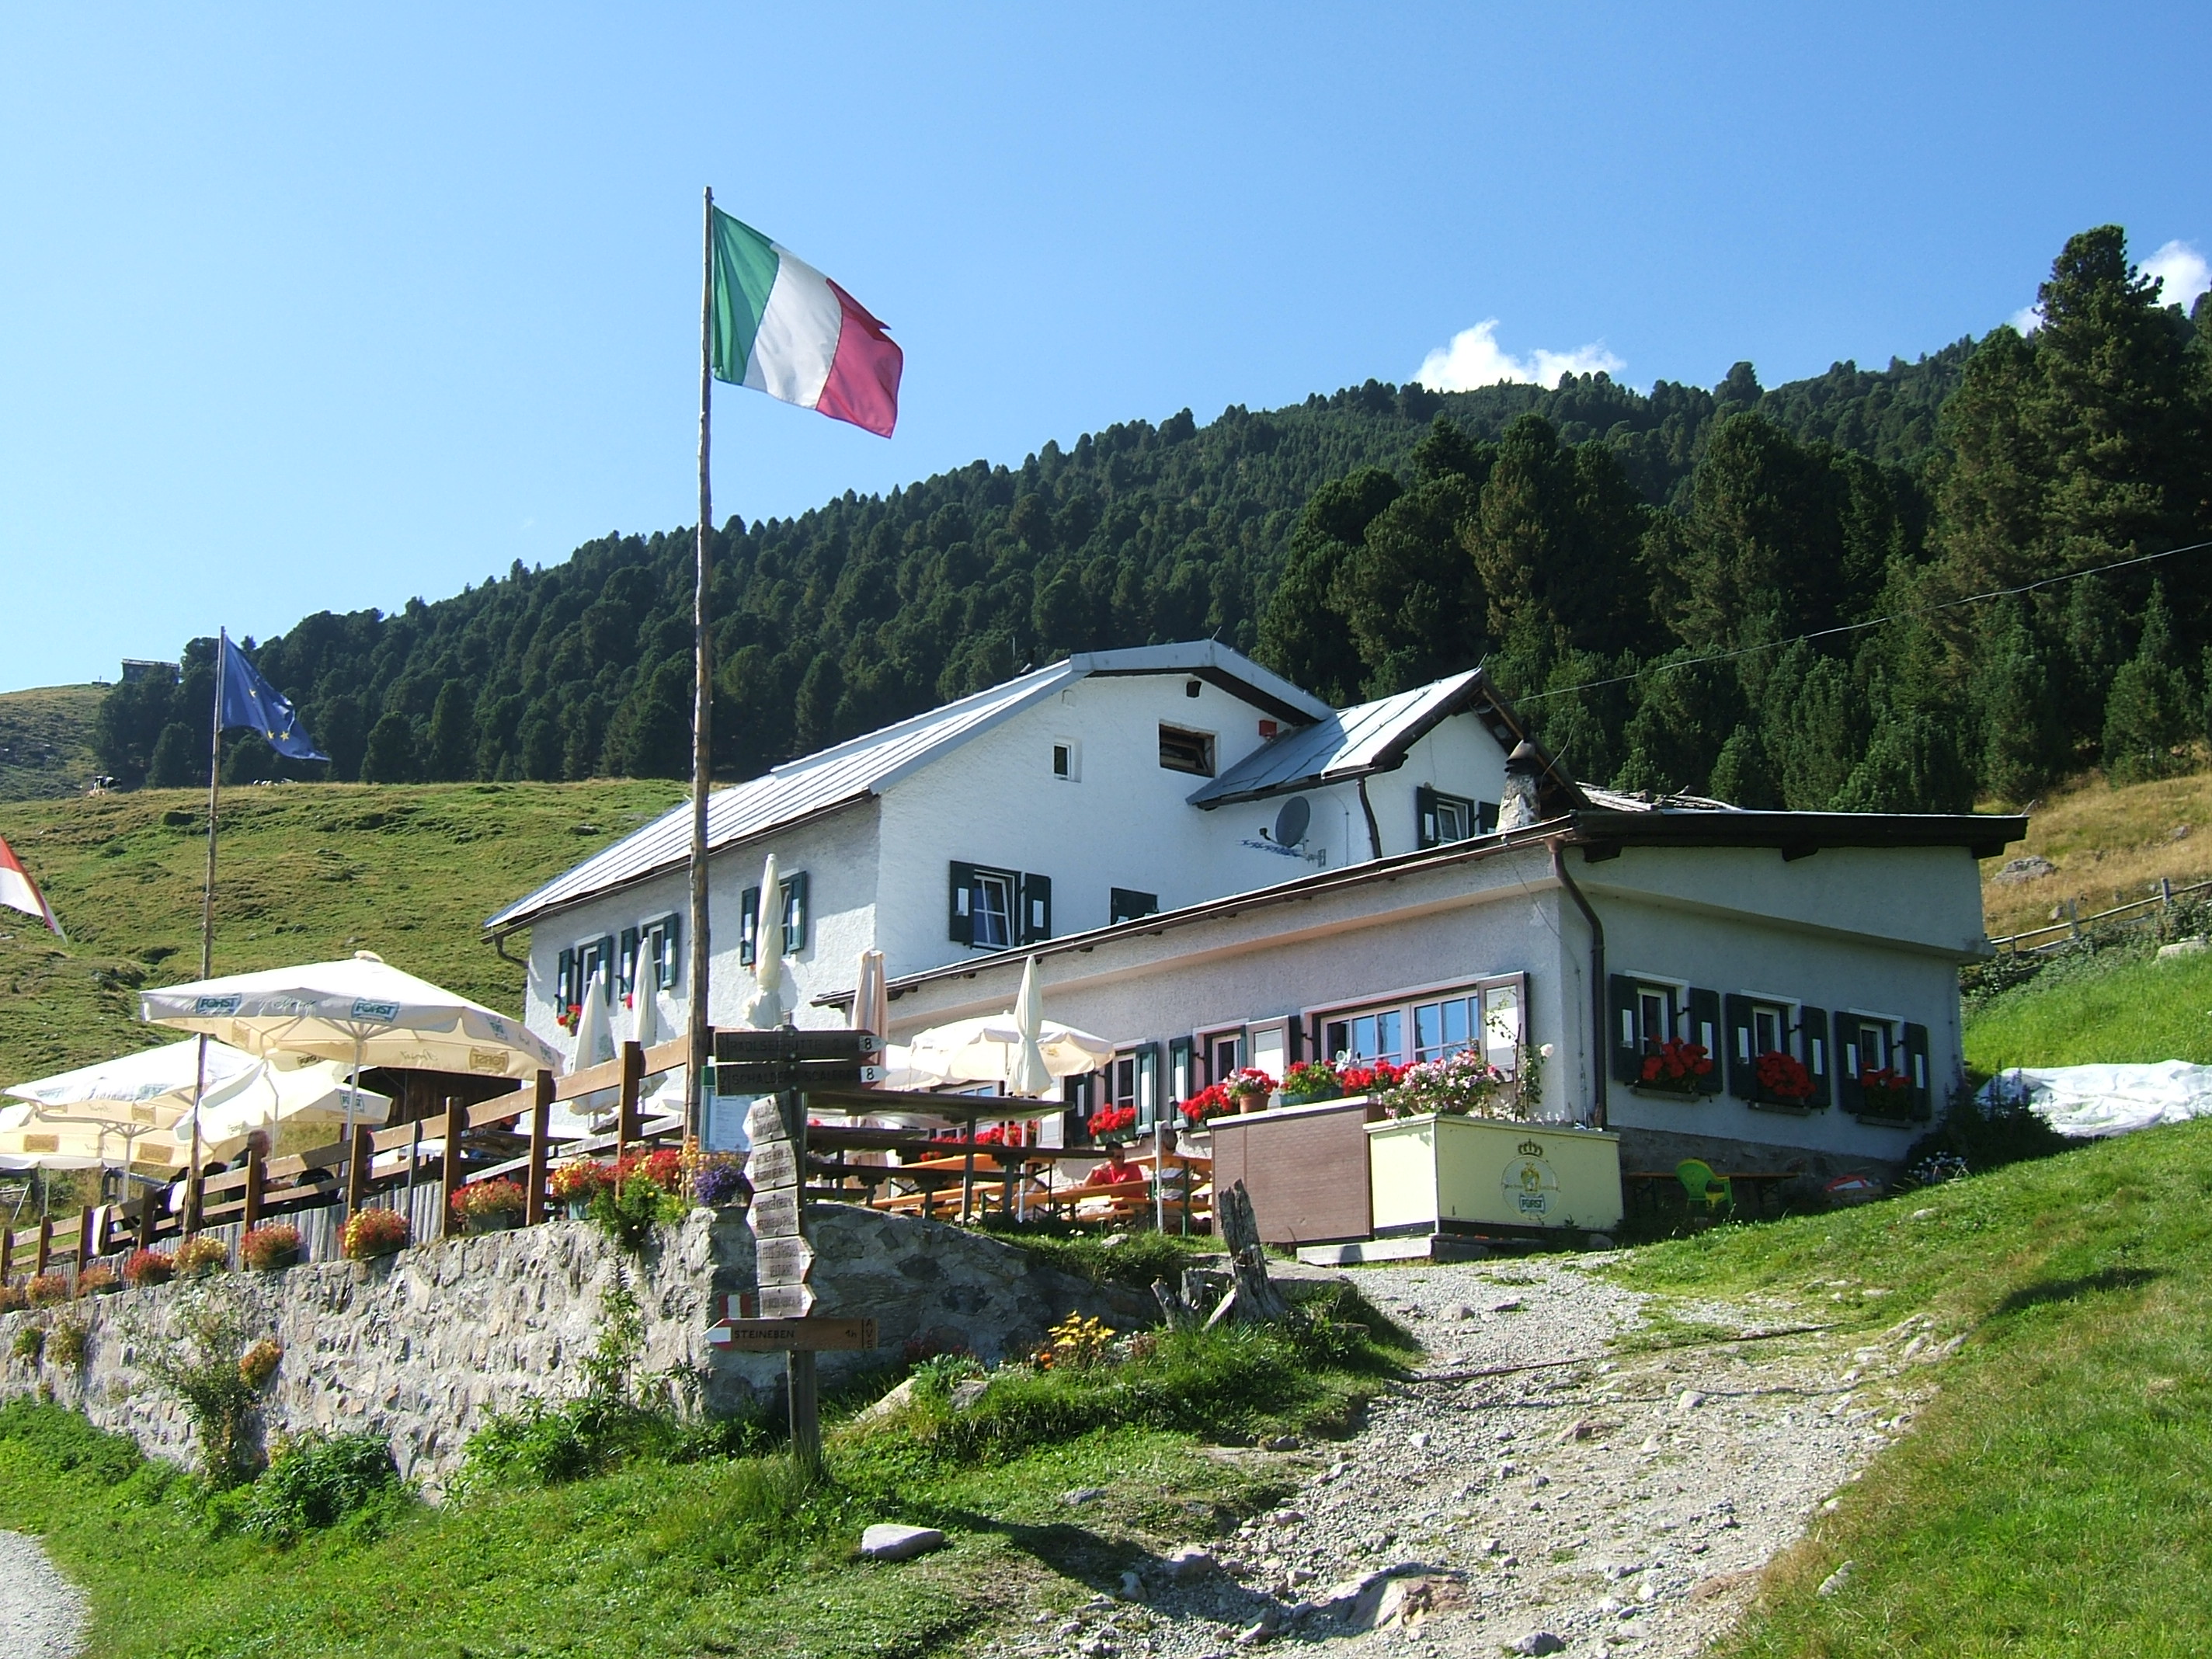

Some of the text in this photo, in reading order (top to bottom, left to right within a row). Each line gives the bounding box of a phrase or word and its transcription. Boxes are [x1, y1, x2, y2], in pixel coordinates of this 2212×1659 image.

[200, 998, 238, 1008] FORST
[356, 1002, 395, 1016] FORST
[864, 1038, 872, 1050] 8
[867, 1067, 875, 1080] 8
[1522, 1199, 1542, 1209] FORST
[735, 1330, 795, 1339] STEINEBEN
